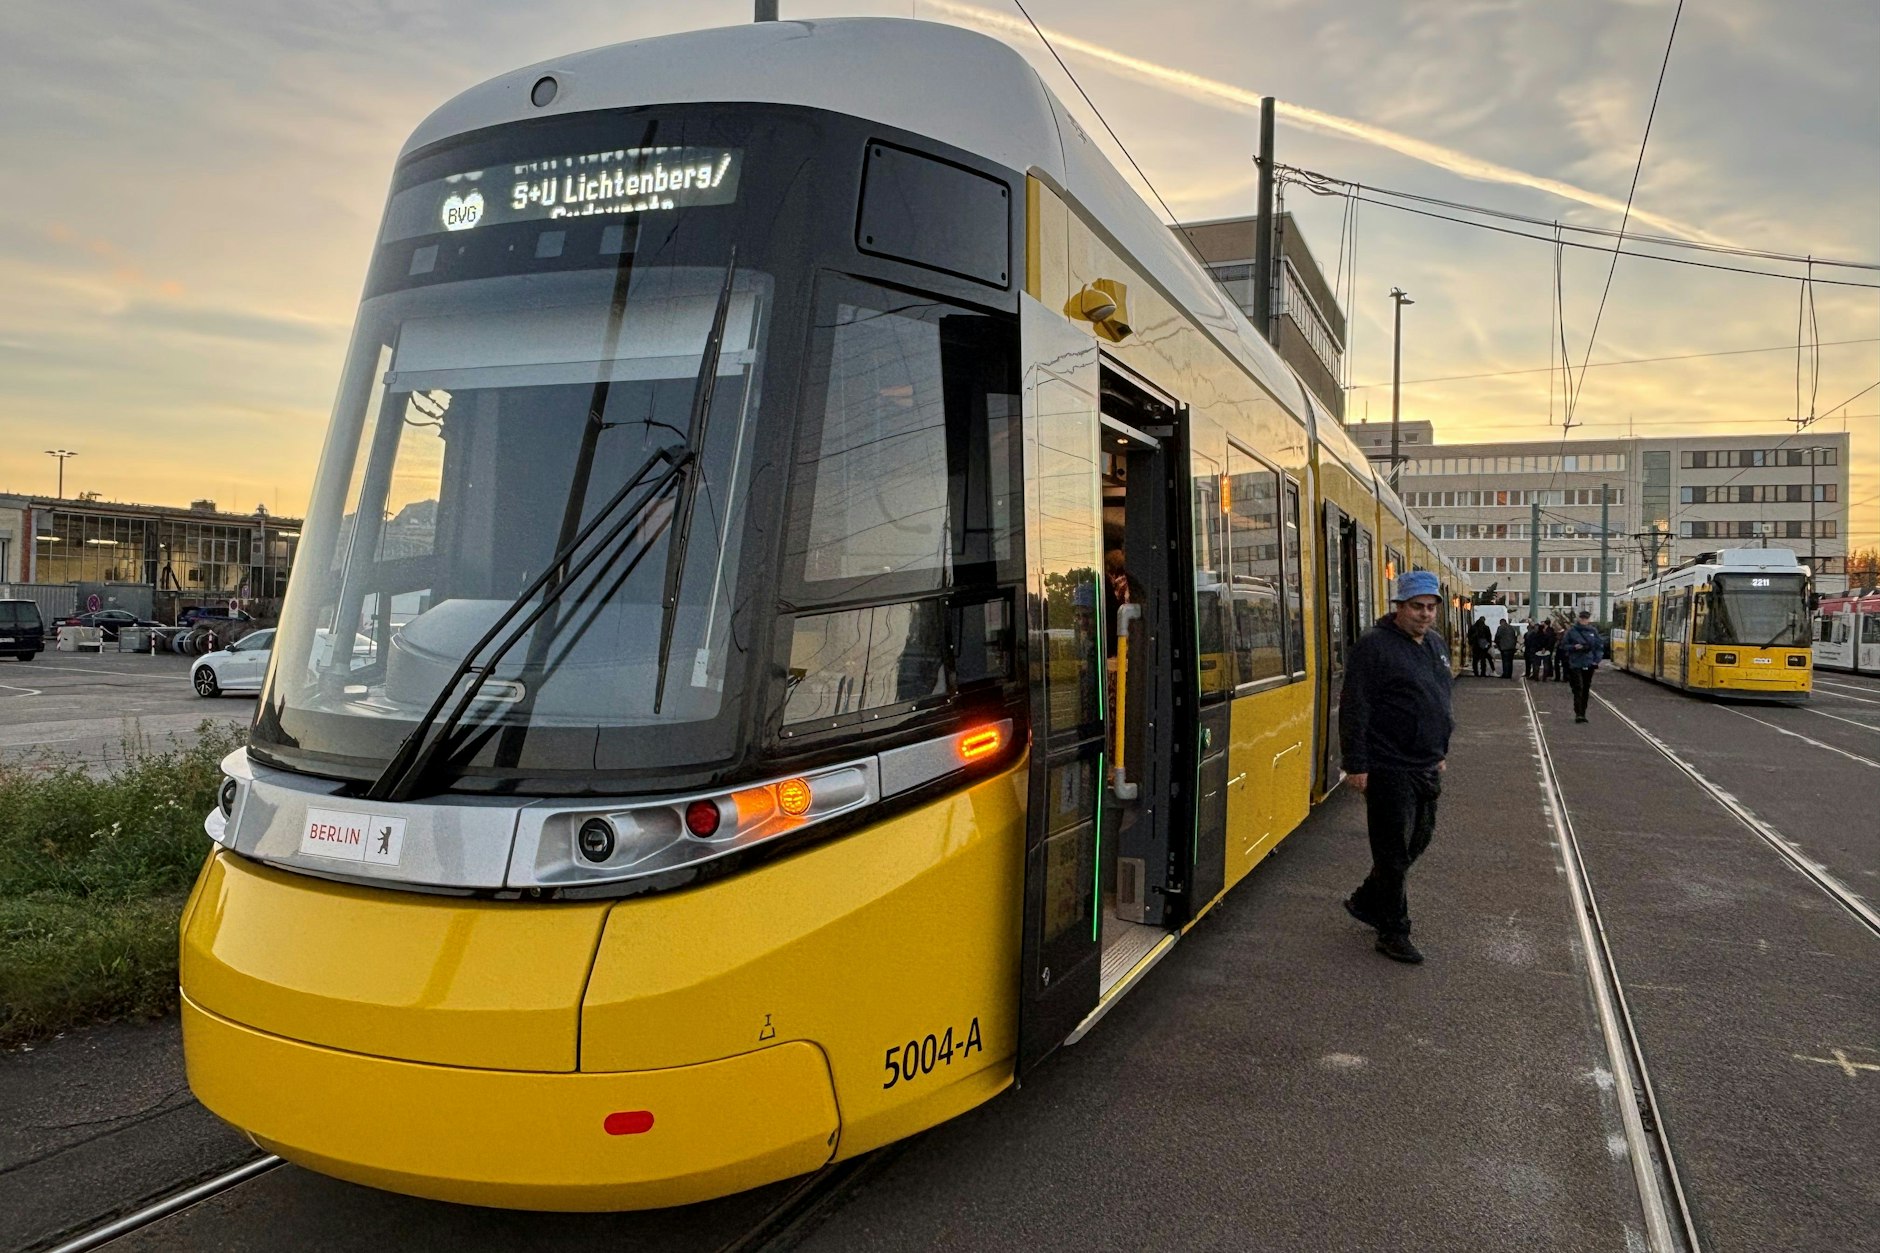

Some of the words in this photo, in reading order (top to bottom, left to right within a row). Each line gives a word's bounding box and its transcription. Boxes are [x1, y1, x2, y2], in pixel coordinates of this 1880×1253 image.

[511, 180, 558, 210] S+U
[562, 153, 732, 204] Lichtenberg/
[448, 206, 477, 225] BVG
[1752, 578, 1770, 587] 2211
[309, 823, 361, 845] BERLIN
[883, 1017, 982, 1090] 5004-A
